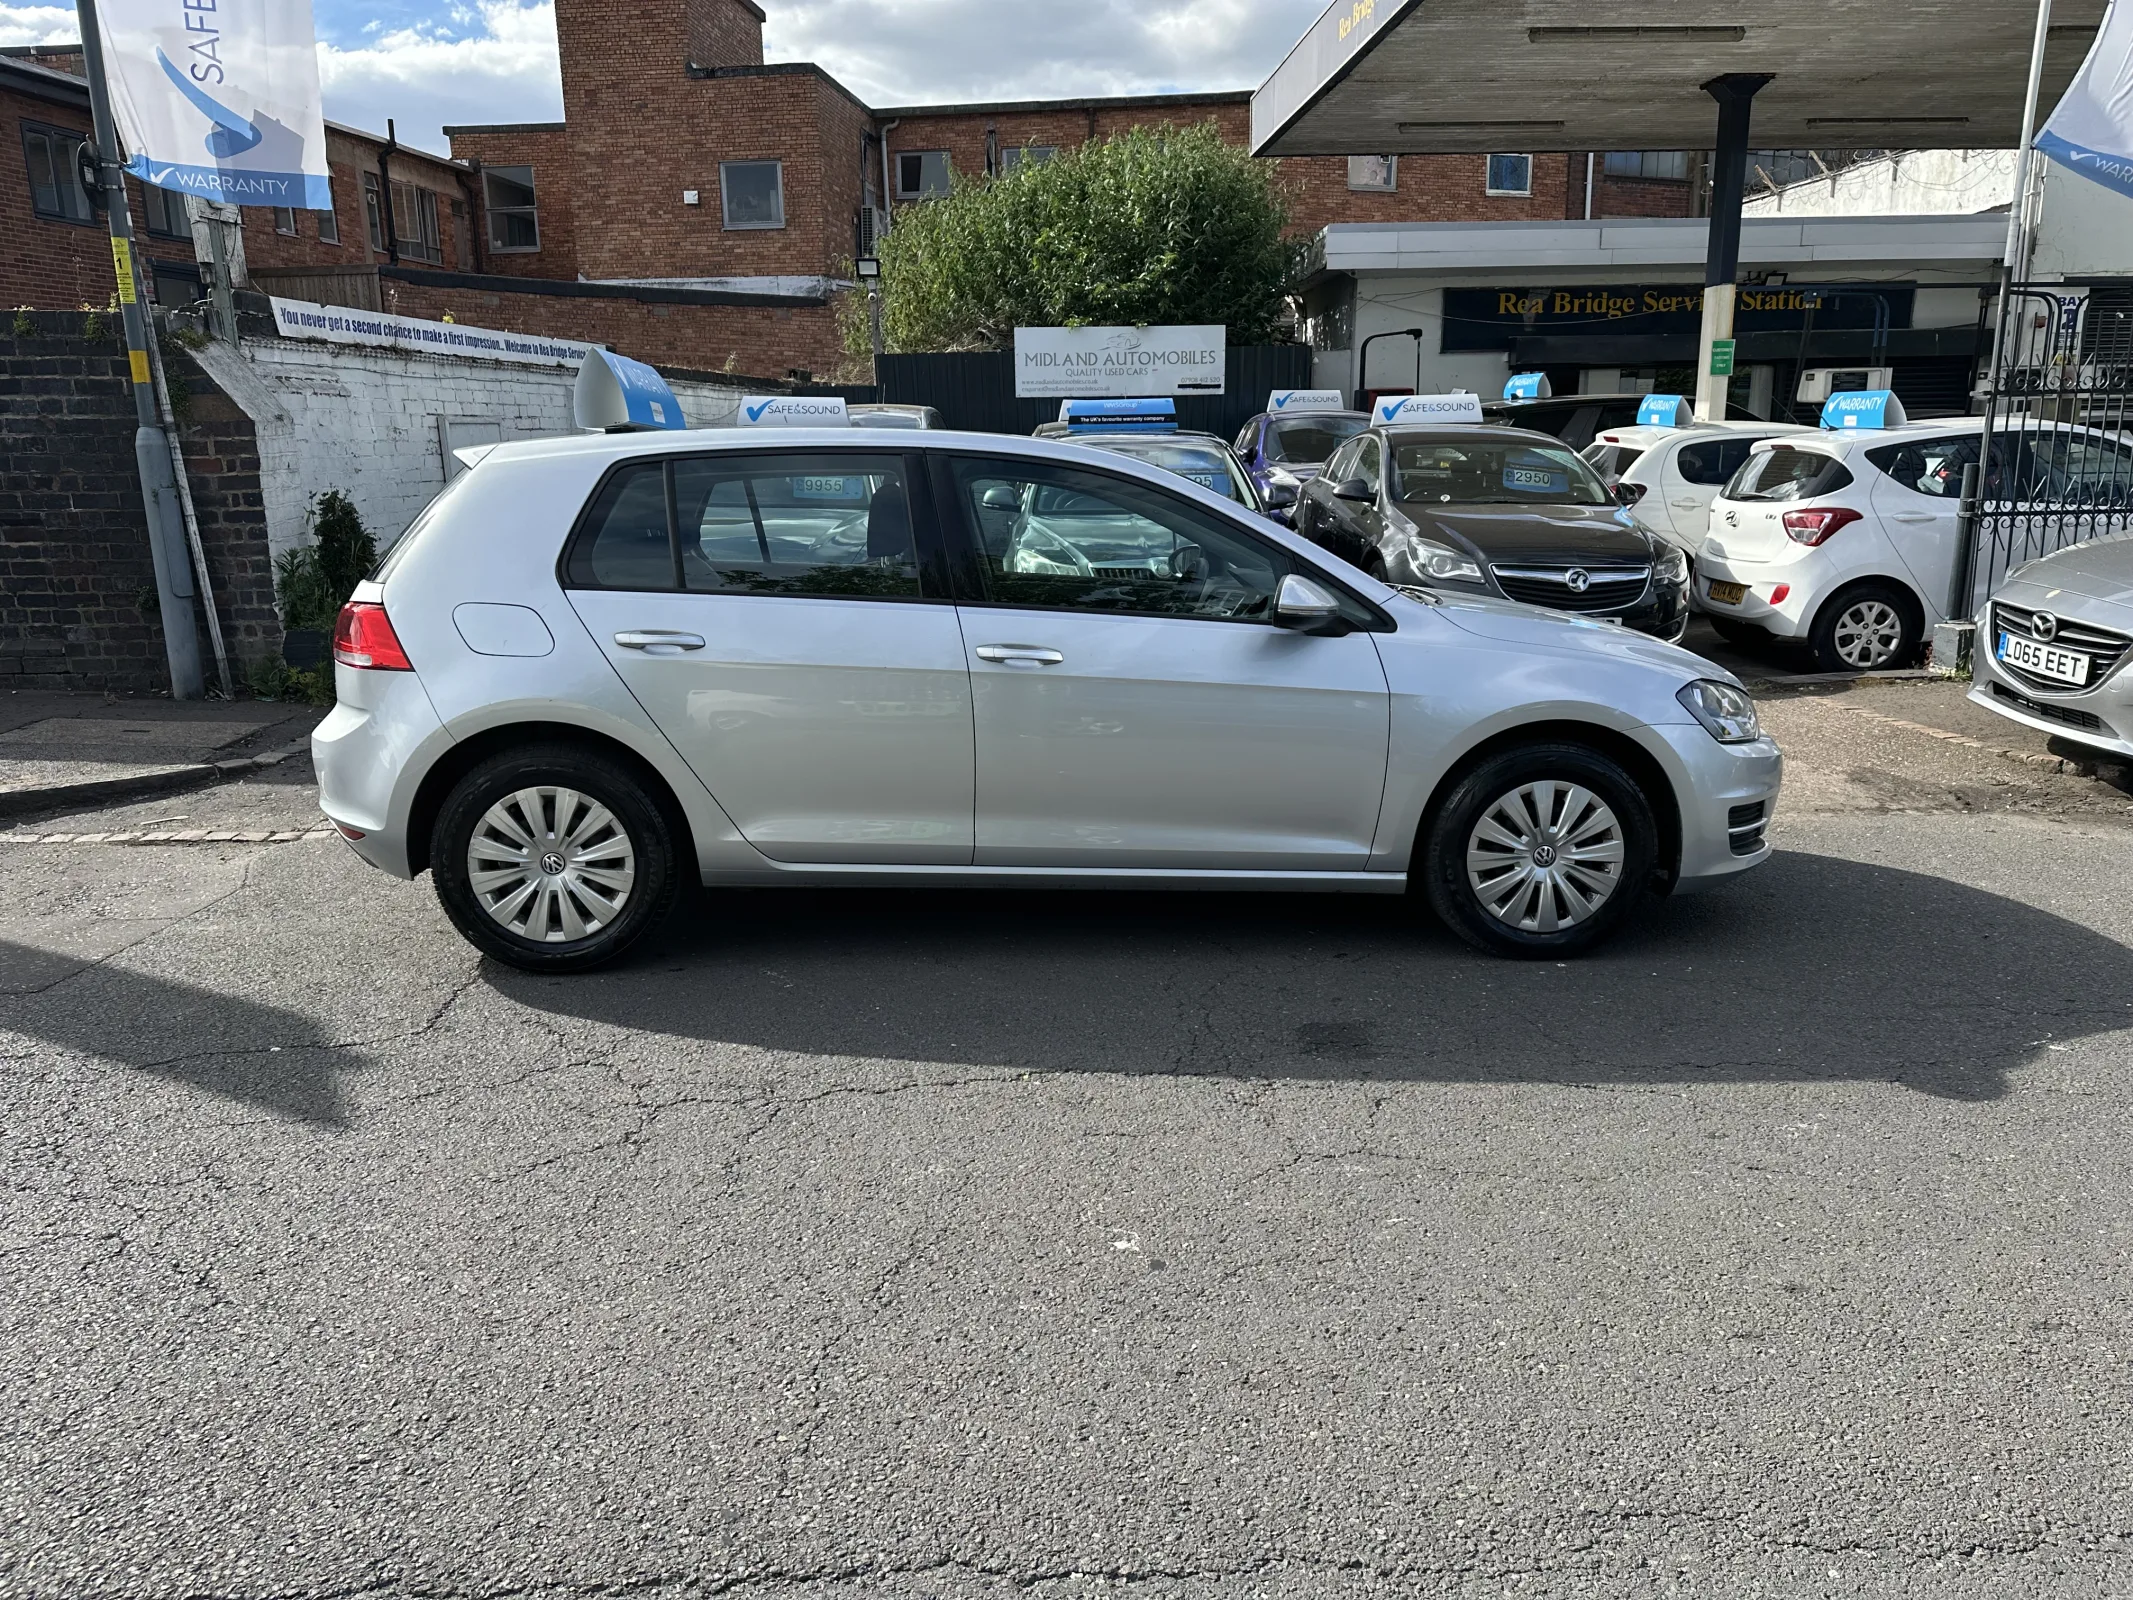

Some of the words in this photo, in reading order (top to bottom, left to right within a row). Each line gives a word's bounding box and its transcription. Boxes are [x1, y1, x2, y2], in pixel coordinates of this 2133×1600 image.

[183, 0, 224, 84] SAFE
[2096, 157, 2133, 183] WAR
[175, 171, 289, 195] WARRANTY
[116, 256, 123, 270] 1
[1497, 292, 1544, 314] Rea
[1552, 291, 1636, 319] Bridge
[1642, 290, 1705, 312] Servi
[280, 306, 299, 325] You
[300, 312, 326, 328] never
[328, 316, 343, 332] get
[344, 320, 351, 332] a
[351, 319, 382, 336] second
[383, 322, 412, 339] chance
[413, 327, 421, 341] to
[422, 329, 442, 343] make
[443, 334, 449, 344] a
[449, 331, 465, 346] first
[504, 338, 532, 355] Welcome
[532, 343, 539, 356] to
[539, 343, 549, 357] Rea
[549, 344, 568, 360] Bridge
[1024, 352, 1098, 367] MIDLAND
[1102, 350, 1216, 366] AUTOMOBILES
[1065, 367, 1102, 377] QUALITY
[1104, 367, 1125, 376] USED
[1126, 367, 1149, 376] CARS
[1289, 395, 1339, 404] SAFE&SOUND
[1402, 402, 1475, 413] SAFE&SOUND
[1648, 399, 1677, 412] WARRANTY
[1838, 396, 1884, 411] WARRANTY
[767, 403, 841, 415] SAFE&SOUND
[2045, 650, 2082, 678] EET
